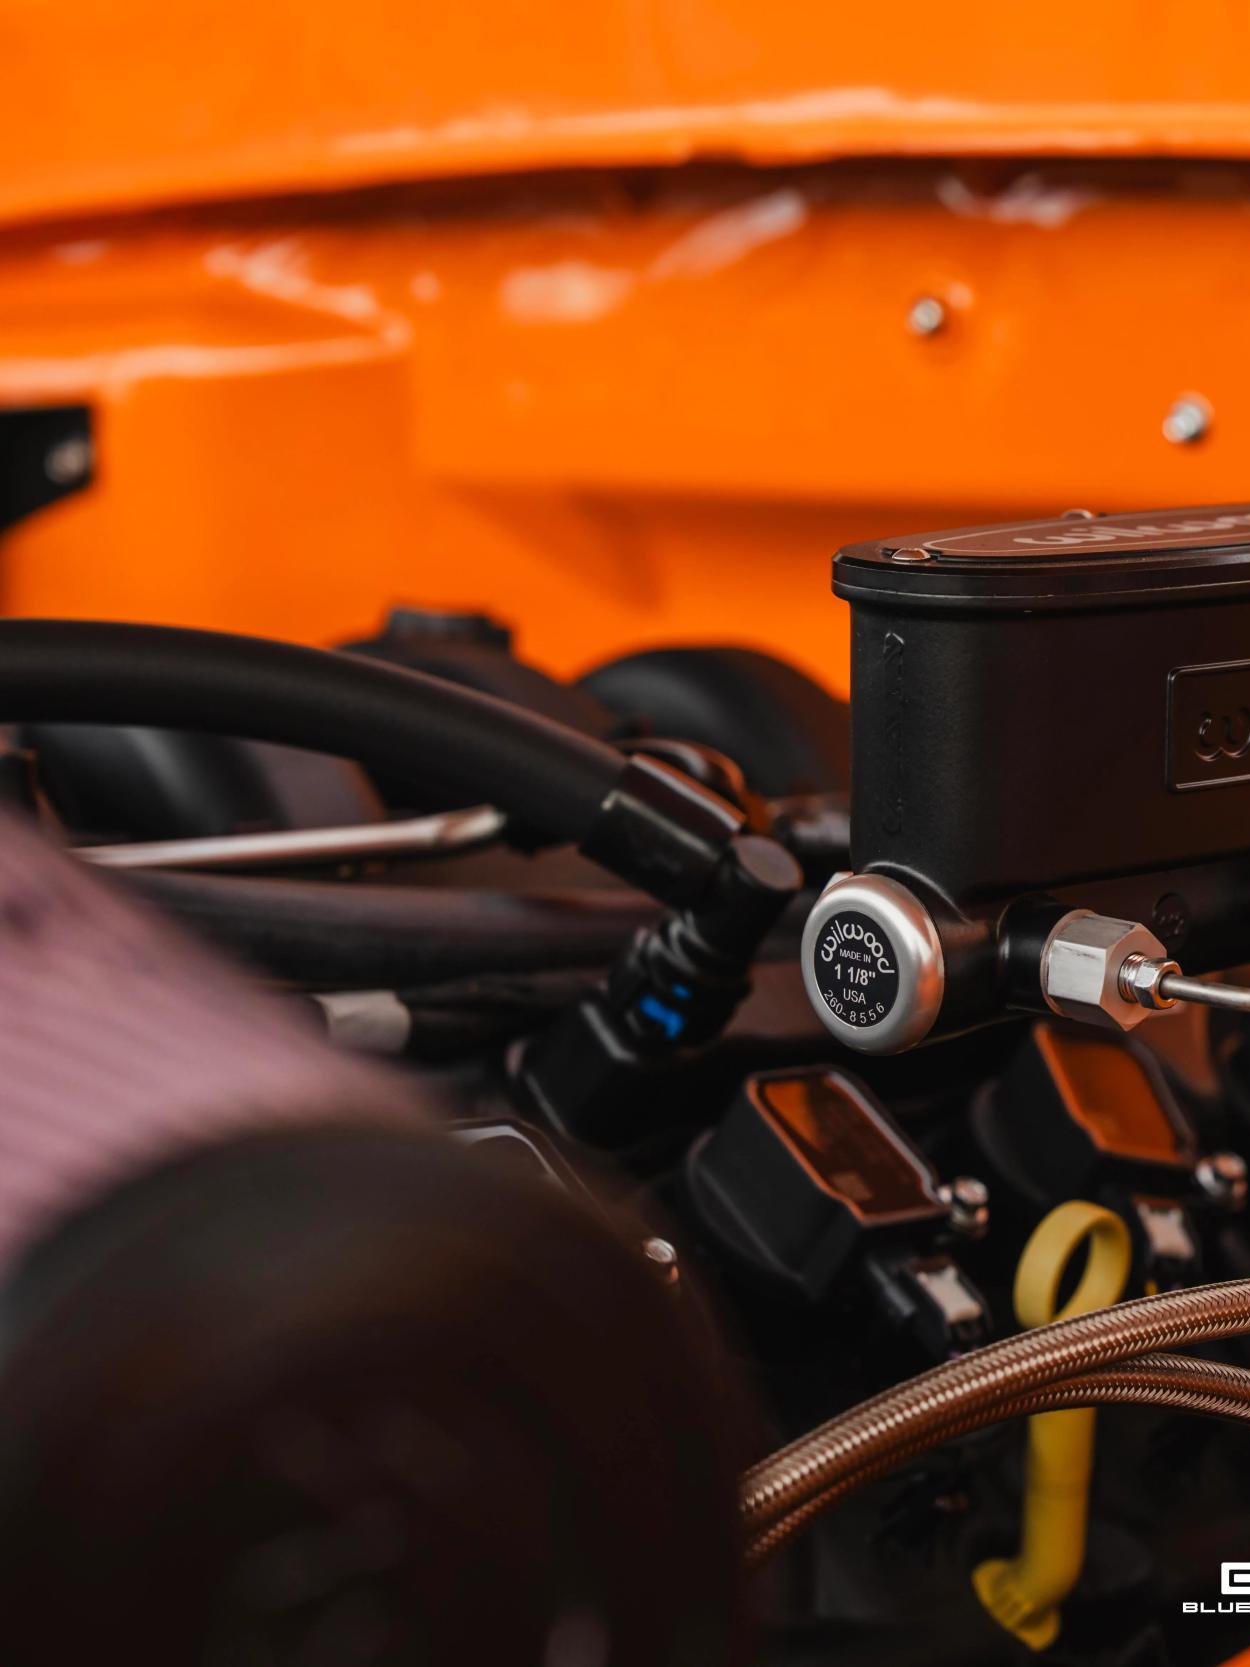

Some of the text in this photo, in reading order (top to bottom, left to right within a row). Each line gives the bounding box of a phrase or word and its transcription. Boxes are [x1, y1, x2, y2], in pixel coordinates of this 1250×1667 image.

[821, 920, 895, 974] wilwood
[839, 948, 871, 963] MADE IN
[834, 963, 876, 986] 1 1/8"
[843, 988, 866, 1005] USA
